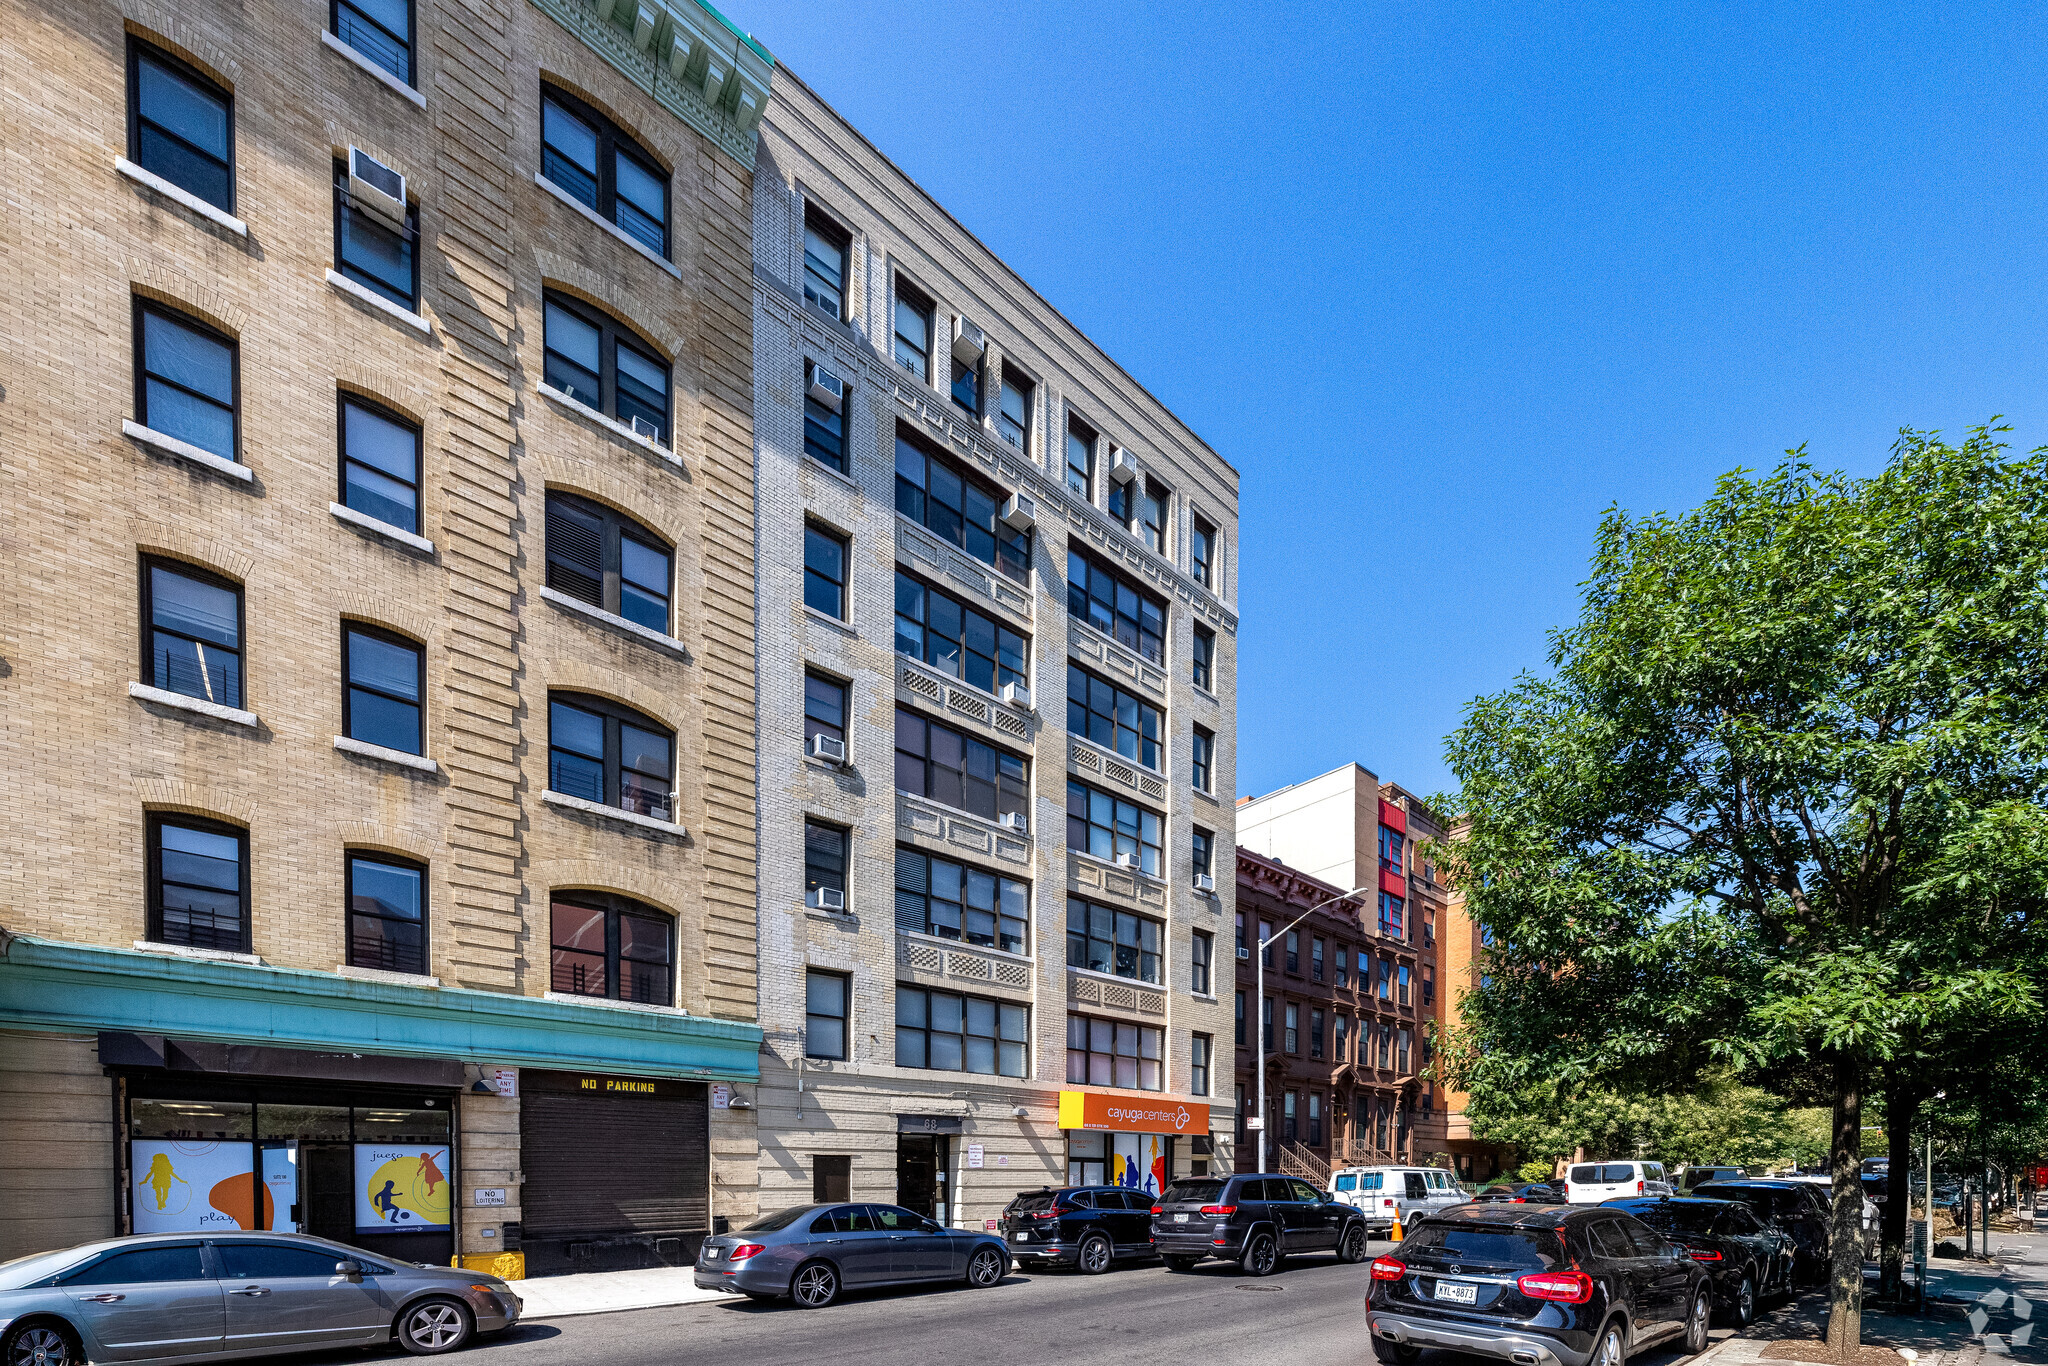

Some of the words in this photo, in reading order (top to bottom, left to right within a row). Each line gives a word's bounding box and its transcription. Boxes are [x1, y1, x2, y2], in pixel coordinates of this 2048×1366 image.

[582, 1079, 596, 1089] NO
[606, 1080, 654, 1092] PARKING
[1107, 1107, 1176, 1123] cayugacenters
[924, 1119, 937, 1130] 68
[200, 1212, 235, 1226] play
